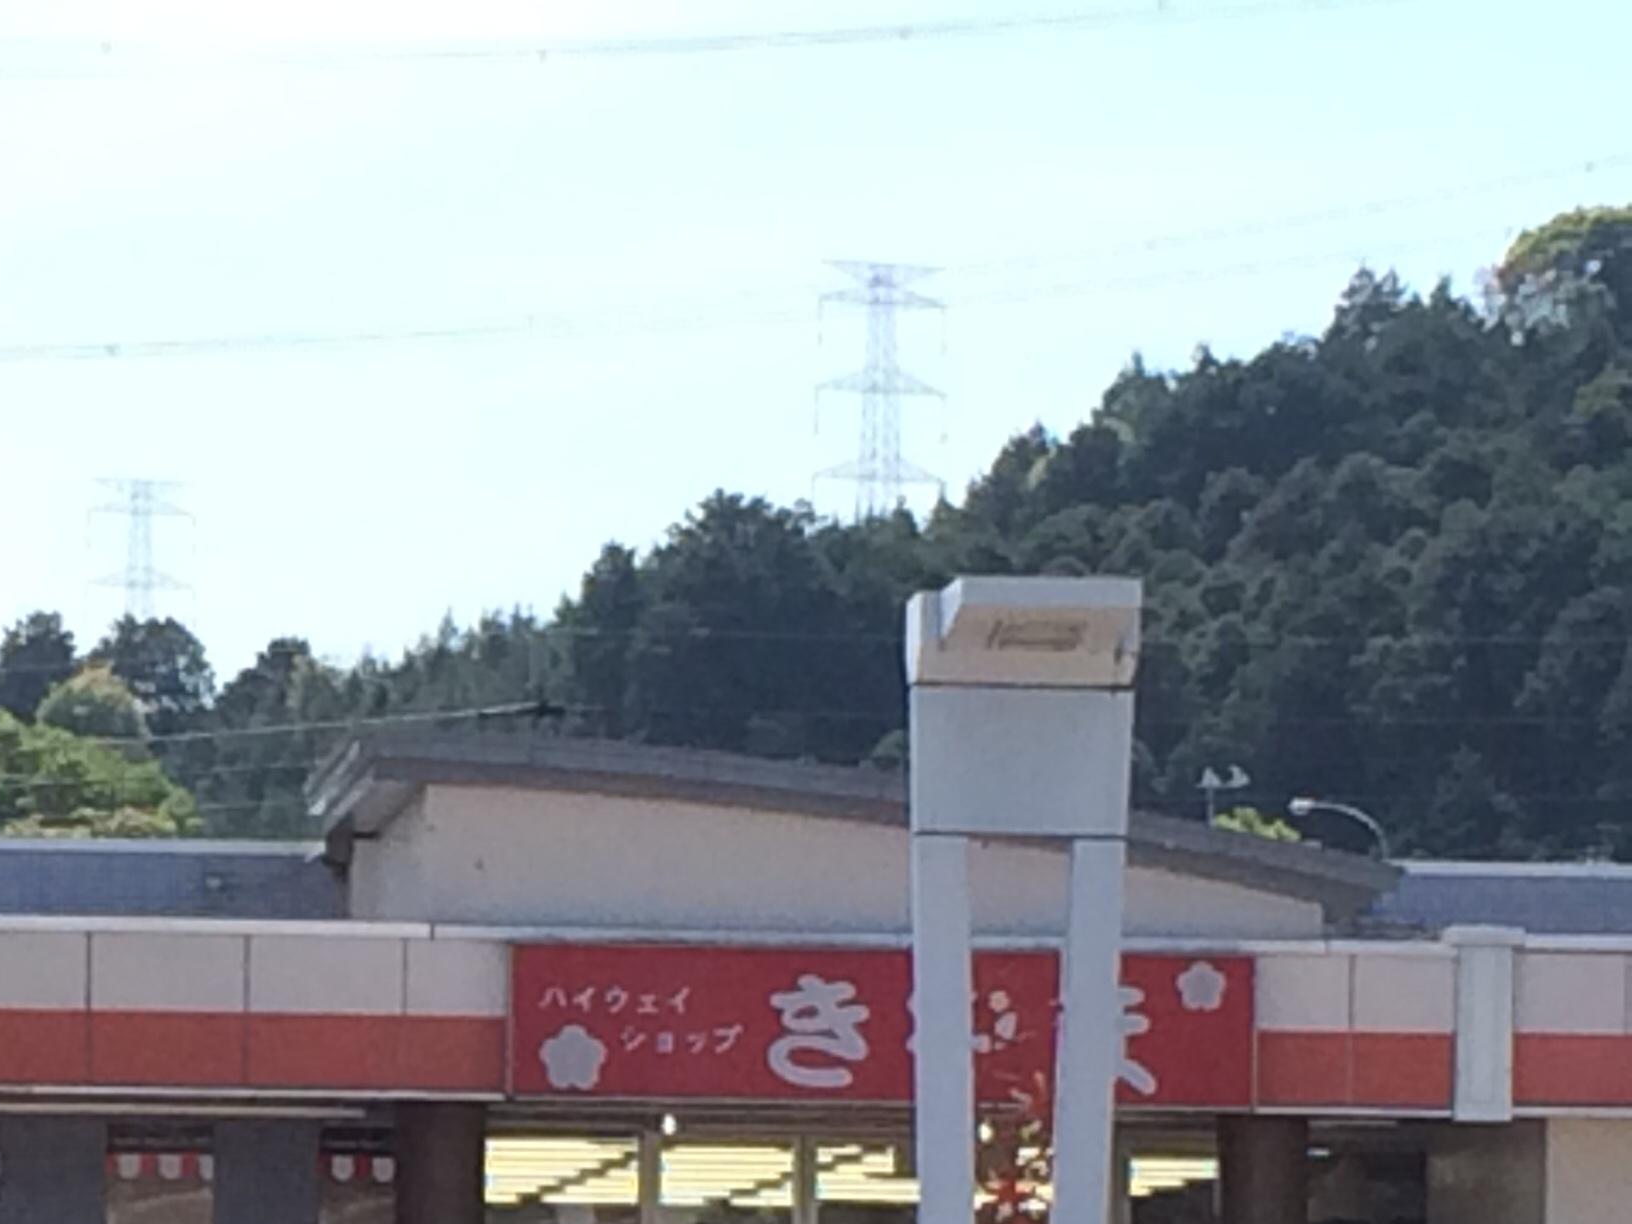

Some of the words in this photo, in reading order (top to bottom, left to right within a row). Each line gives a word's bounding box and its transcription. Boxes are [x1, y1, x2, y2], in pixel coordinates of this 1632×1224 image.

[538, 985, 690, 1015] ハイウェイ
[620, 1023, 745, 1054] ショップ
